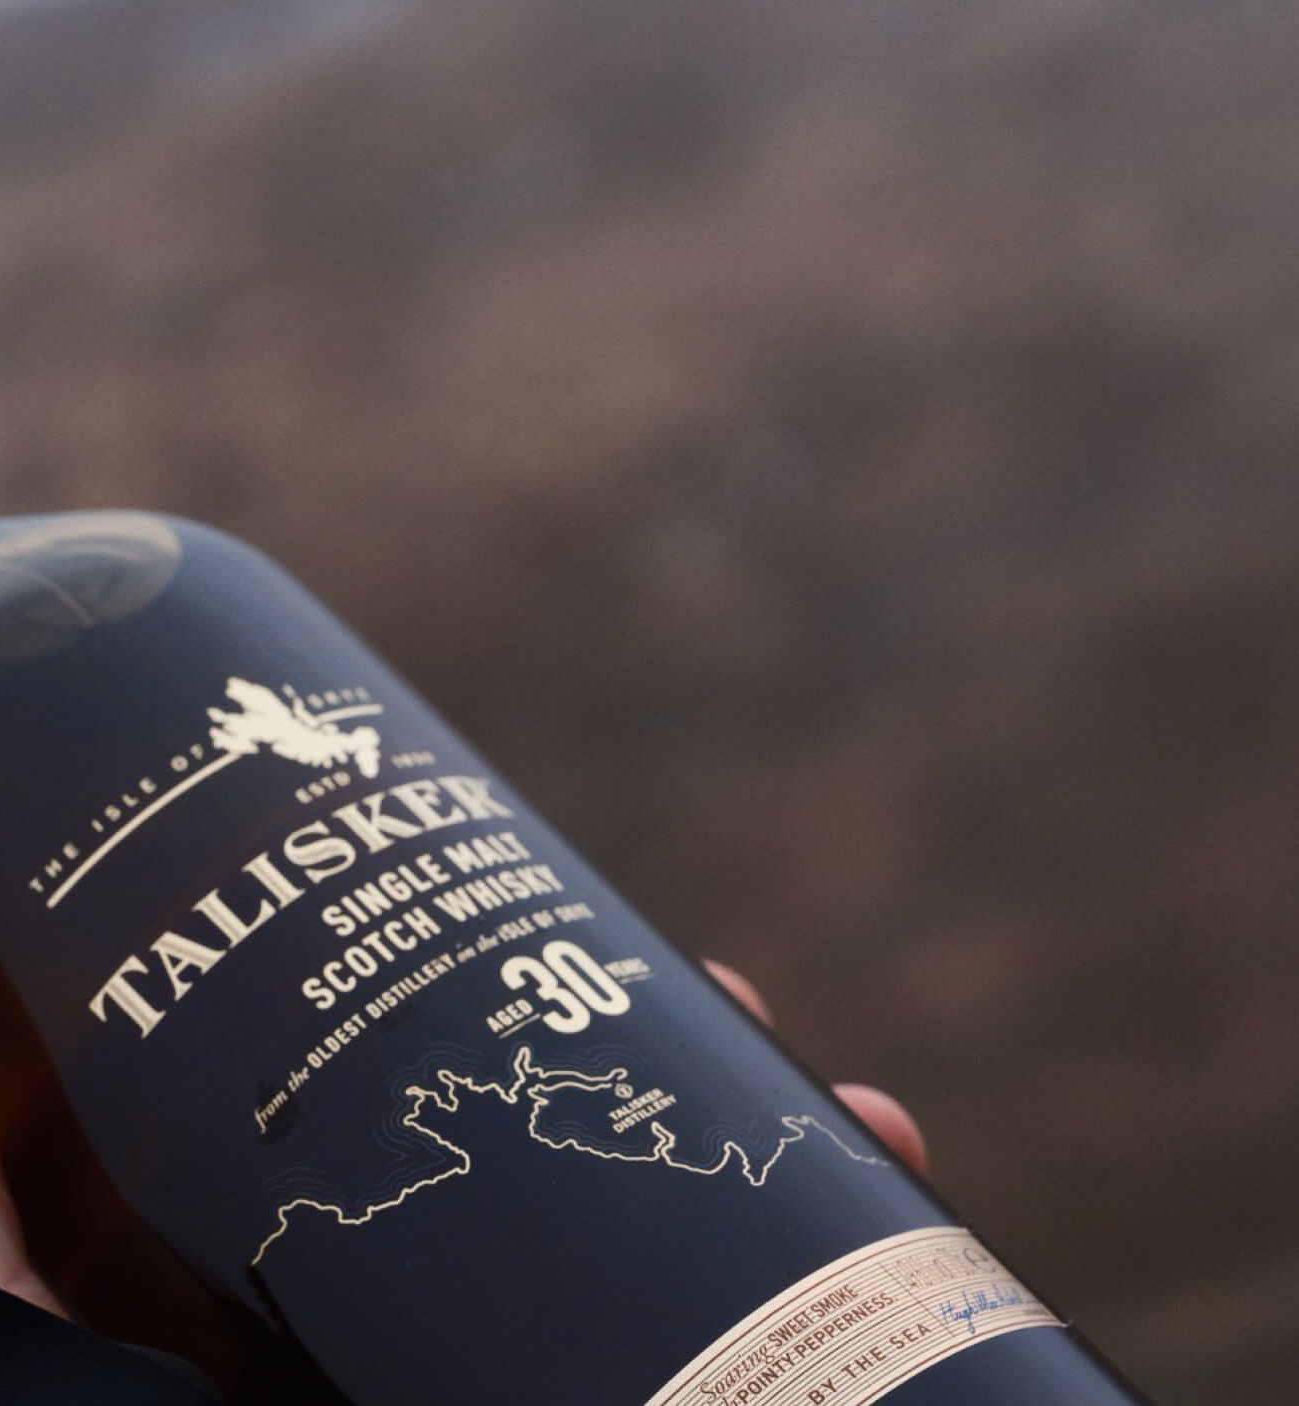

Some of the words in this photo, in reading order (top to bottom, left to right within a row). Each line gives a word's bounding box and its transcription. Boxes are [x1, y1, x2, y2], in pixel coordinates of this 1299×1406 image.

[28, 841, 80, 893] THE
[91, 776, 158, 833] ISLE
[169, 742, 204, 773] OF
[294, 770, 351, 804] ESTD
[88, 774, 516, 1039] TALISKER
[321, 852, 452, 937] SINGLE
[443, 830, 531, 875] MALT
[301, 905, 442, 1011] SCOTCH
[432, 863, 565, 923] WHISKY
[253, 1089, 290, 1134] from
[287, 1066, 311, 1094] the
[306, 1012, 368, 1069] OLDEST
[364, 952, 458, 1020] DISTILLERY
[476, 933, 500, 953] the
[496, 916, 537, 942] ISLE
[486, 998, 535, 1033] AGED
[499, 940, 632, 1034] 30
[607, 1087, 665, 1121] TALISKER
[612, 1093, 677, 1134] DISTILLERY
[700, 1342, 776, 1406] Soaring
[766, 1309, 815, 1348] SWEET
[809, 1283, 860, 1319] SMOKE
[735, 1351, 796, 1406] POINTY
[807, 1377, 838, 1406] BY
[840, 1345, 888, 1380] THE
[888, 1322, 932, 1350] SEA
